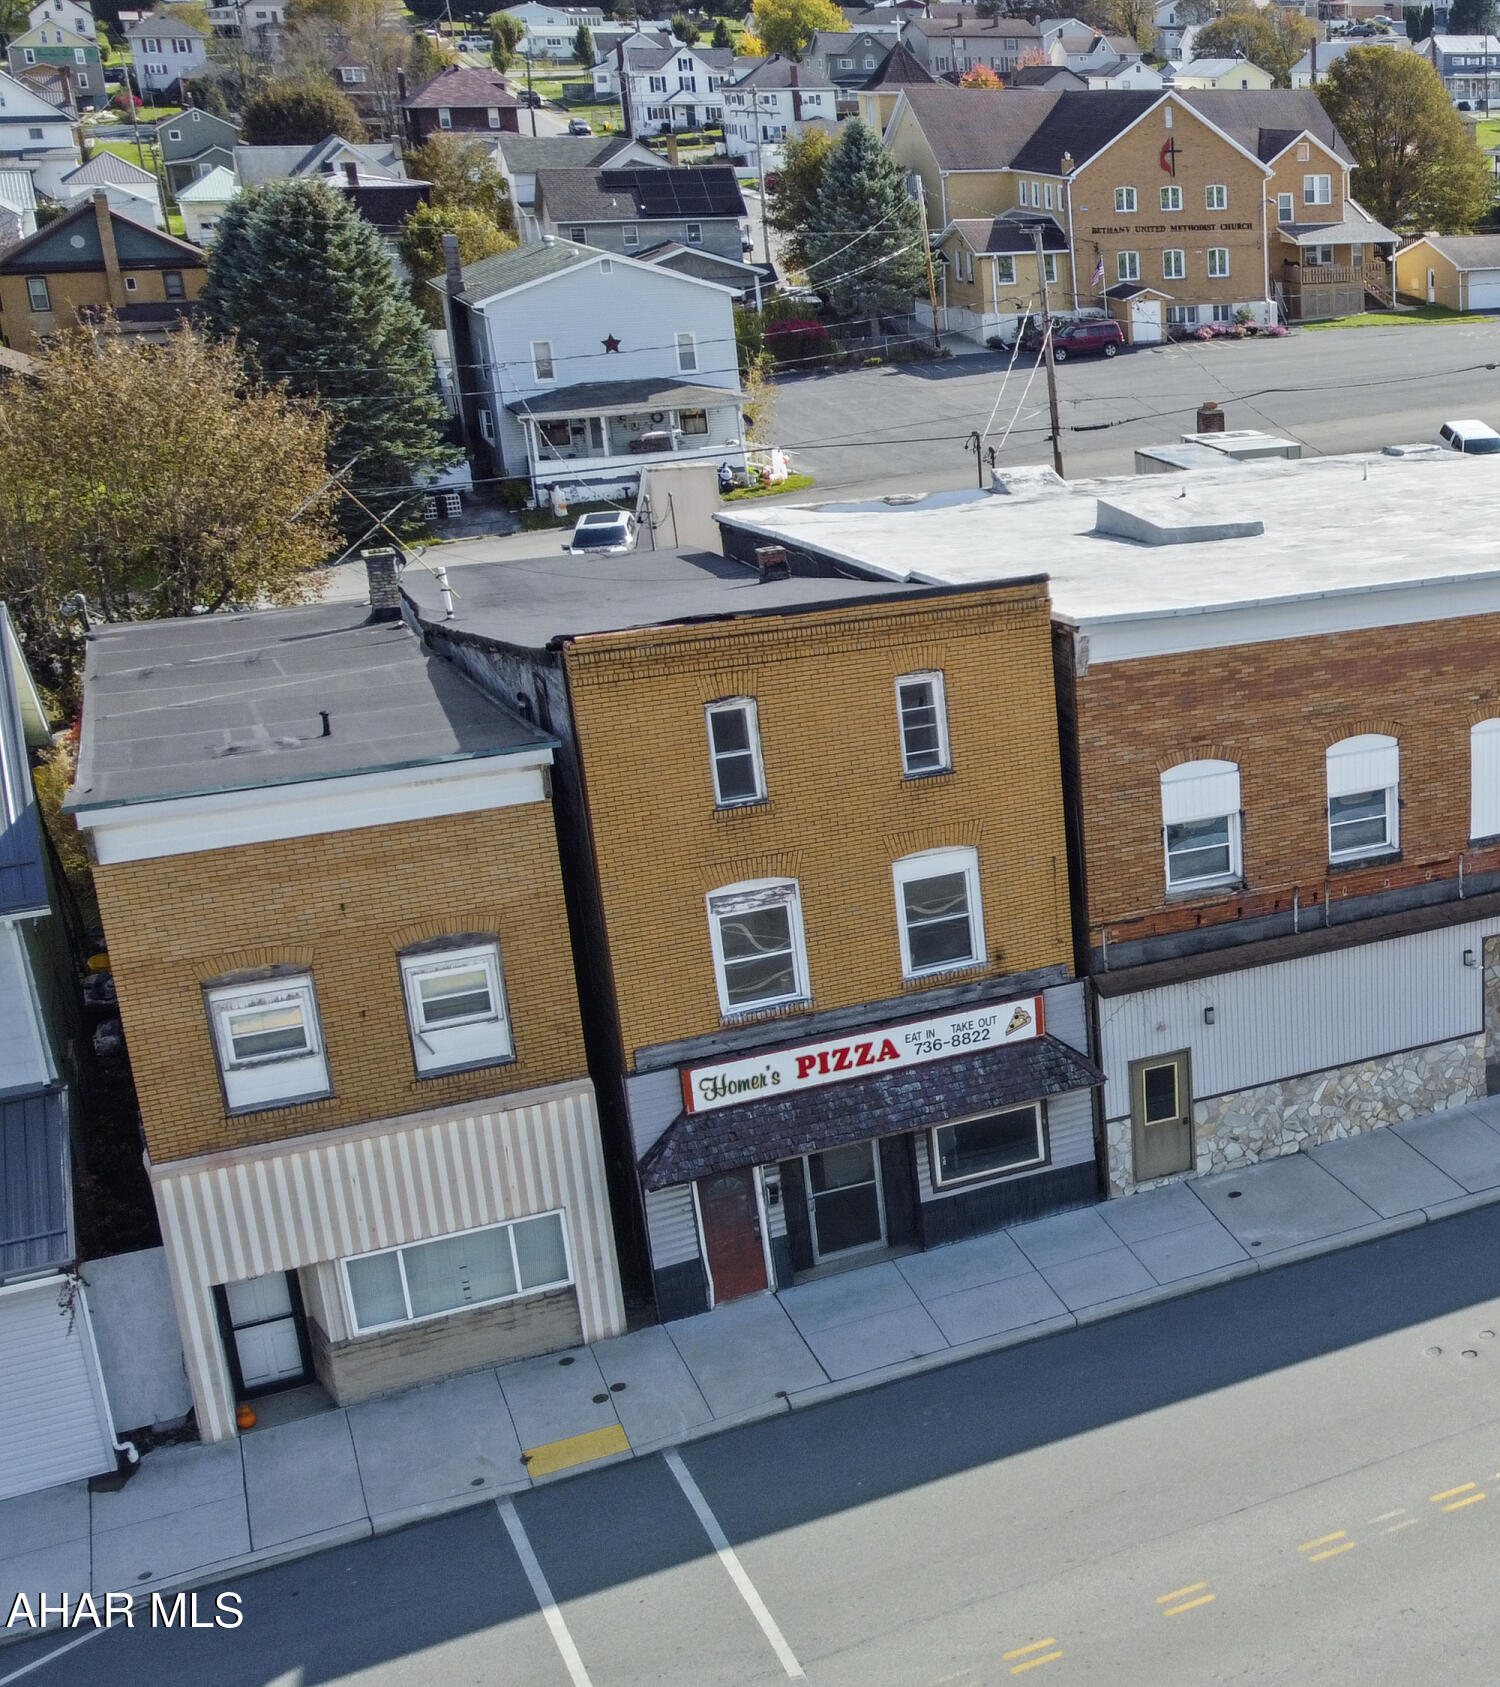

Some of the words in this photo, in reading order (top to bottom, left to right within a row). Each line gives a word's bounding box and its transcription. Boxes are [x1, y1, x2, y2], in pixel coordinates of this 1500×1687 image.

[1092, 226, 1130, 234] BETHANY
[1135, 225, 1166, 233] UNITED
[1170, 223, 1216, 232] METHODIST
[1220, 222, 1253, 231] CHURCH
[904, 1031, 923, 1044] EAT
[925, 1028, 936, 1039] IN
[950, 1020, 975, 1034] TAKE
[978, 1015, 997, 1029] OUT
[913, 1028, 991, 1055] 736-8822
[699, 1064, 781, 1101] Homer's
[795, 1038, 901, 1080] PIZZA
